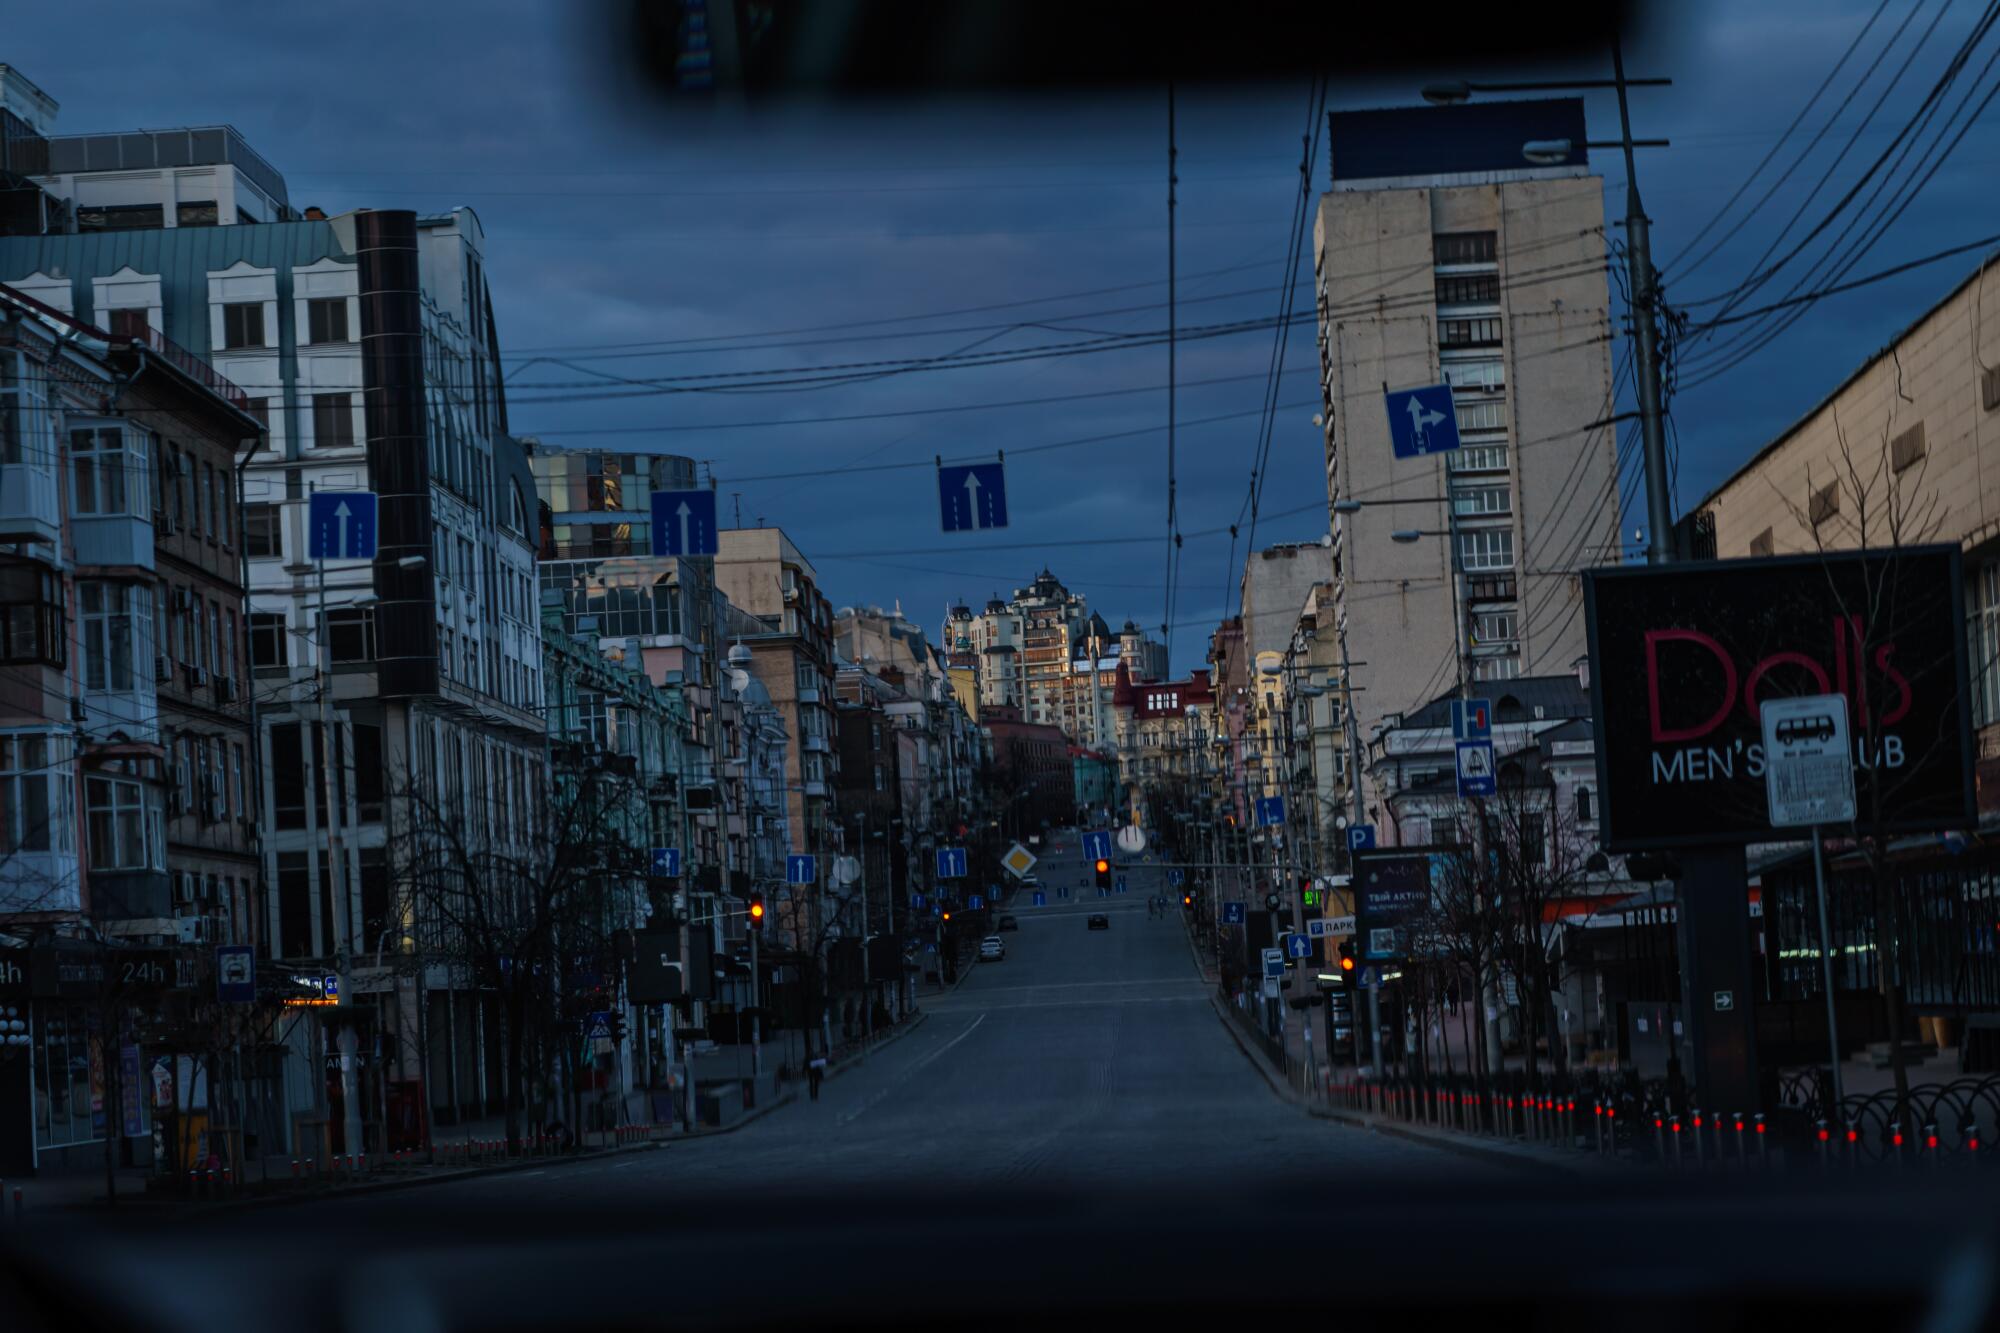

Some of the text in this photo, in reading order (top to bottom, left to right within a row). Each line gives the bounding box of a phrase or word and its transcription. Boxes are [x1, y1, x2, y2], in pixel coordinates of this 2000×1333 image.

[1645, 615, 1912, 742] Dolls
[1652, 737, 1766, 784] MEN'S
[1351, 828, 1366, 849] P
[121, 960, 165, 984] 24h
